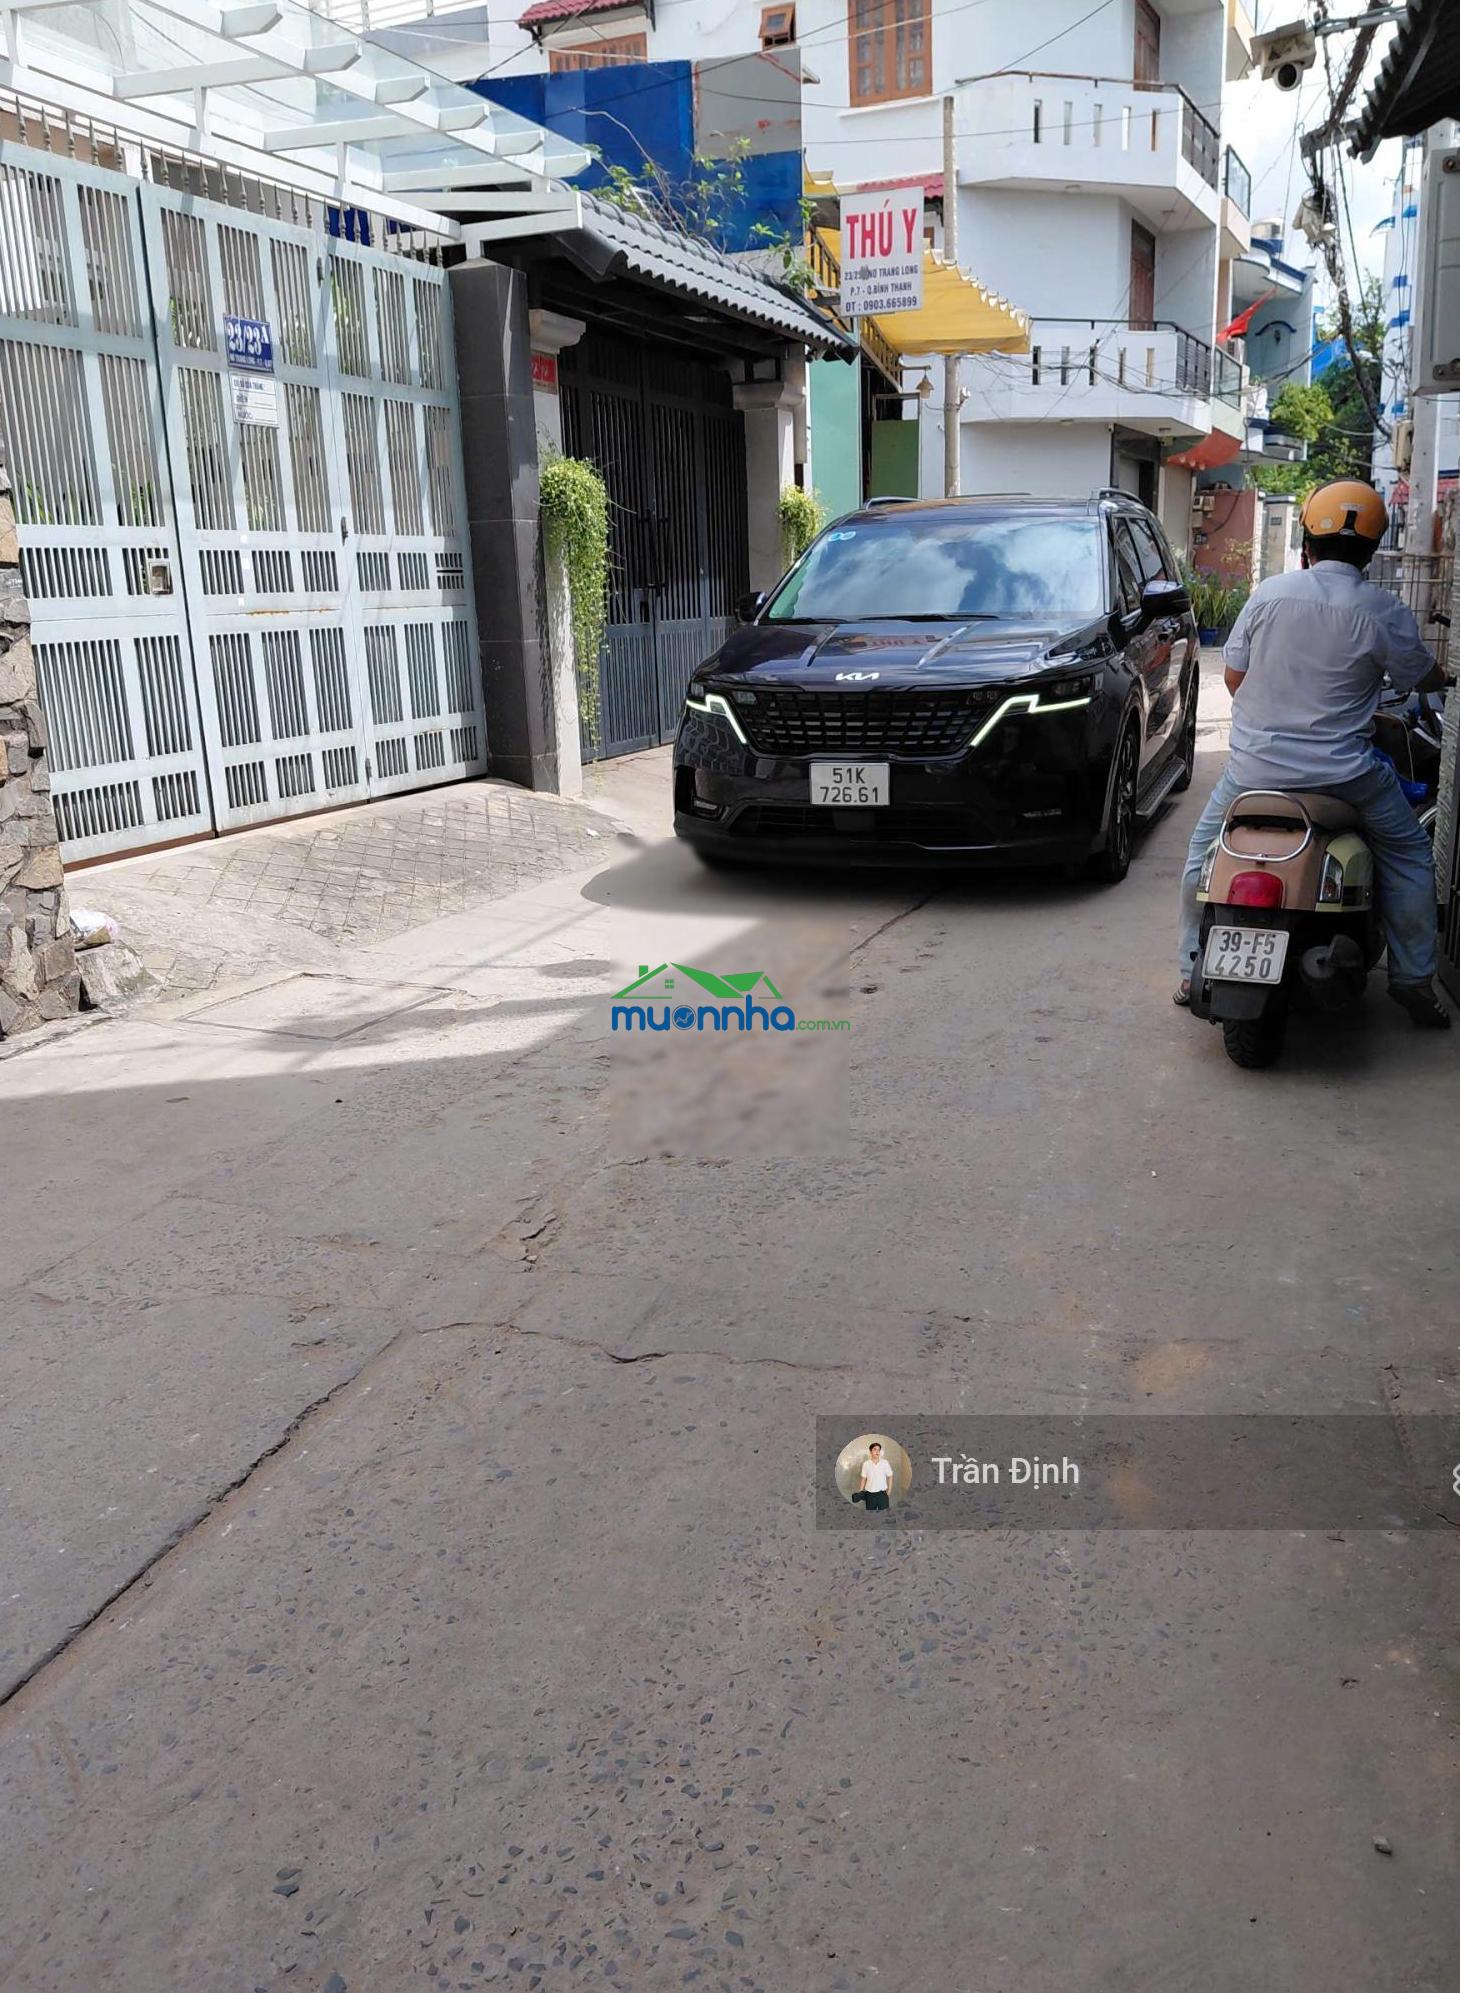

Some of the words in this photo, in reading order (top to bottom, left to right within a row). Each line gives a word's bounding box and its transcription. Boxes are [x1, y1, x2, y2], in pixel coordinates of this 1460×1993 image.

[846, 199, 893, 259] THÚ
[902, 208, 917, 254] Y
[879, 266, 900, 278] TRANG
[901, 265, 918, 275] LONG
[863, 296, 918, 311] 0903.665899
[832, 767, 866, 784] 51K
[820, 786, 879, 803] 726.61
[1218, 930, 1277, 955] 39-F5
[1214, 954, 1272, 979] 4250
